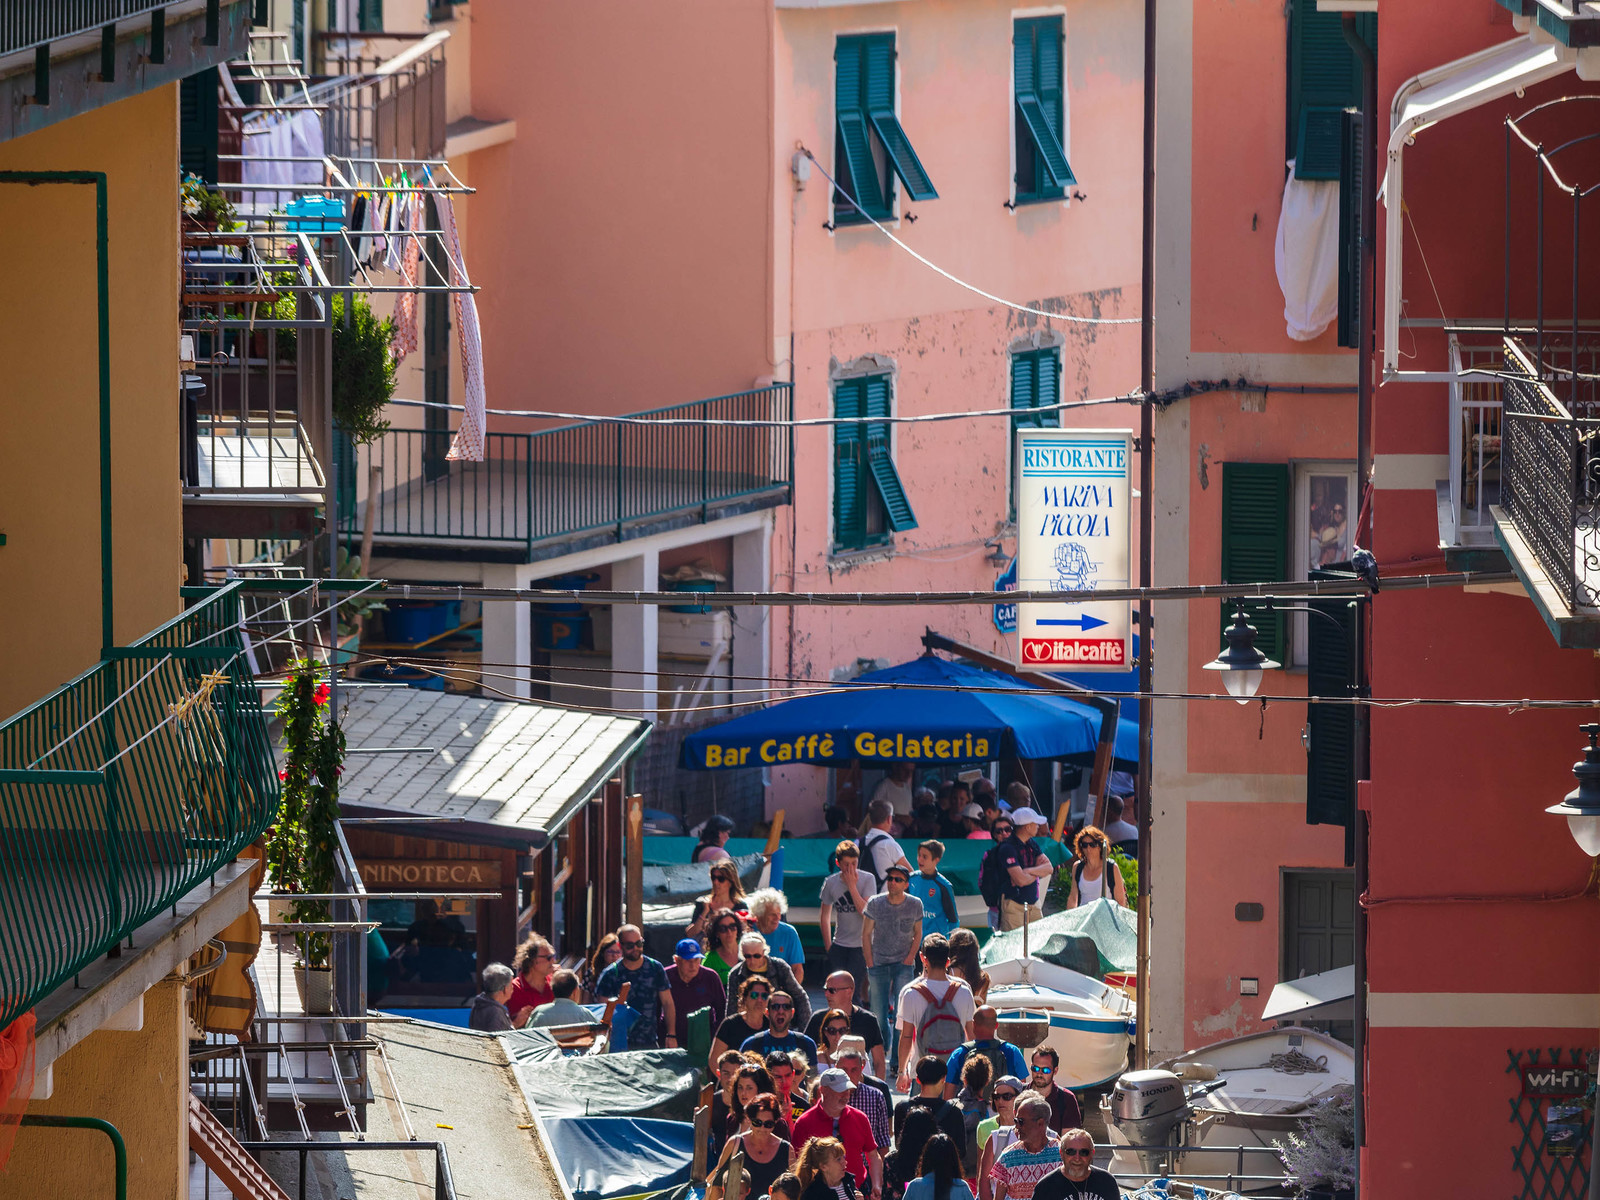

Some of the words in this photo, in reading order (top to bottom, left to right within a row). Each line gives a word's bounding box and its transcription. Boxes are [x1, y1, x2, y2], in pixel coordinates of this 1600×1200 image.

[1023, 448, 1126, 469] RISTORANTE
[1052, 641, 1123, 662] italcaffè
[705, 744, 751, 768] Bar
[759, 733, 835, 763] Caffè
[854, 731, 989, 759] Gelateria
[363, 864, 483, 883] NINOTECA
[1114, 1091, 1124, 1101] 15
[1141, 1084, 1175, 1097] HONDA
